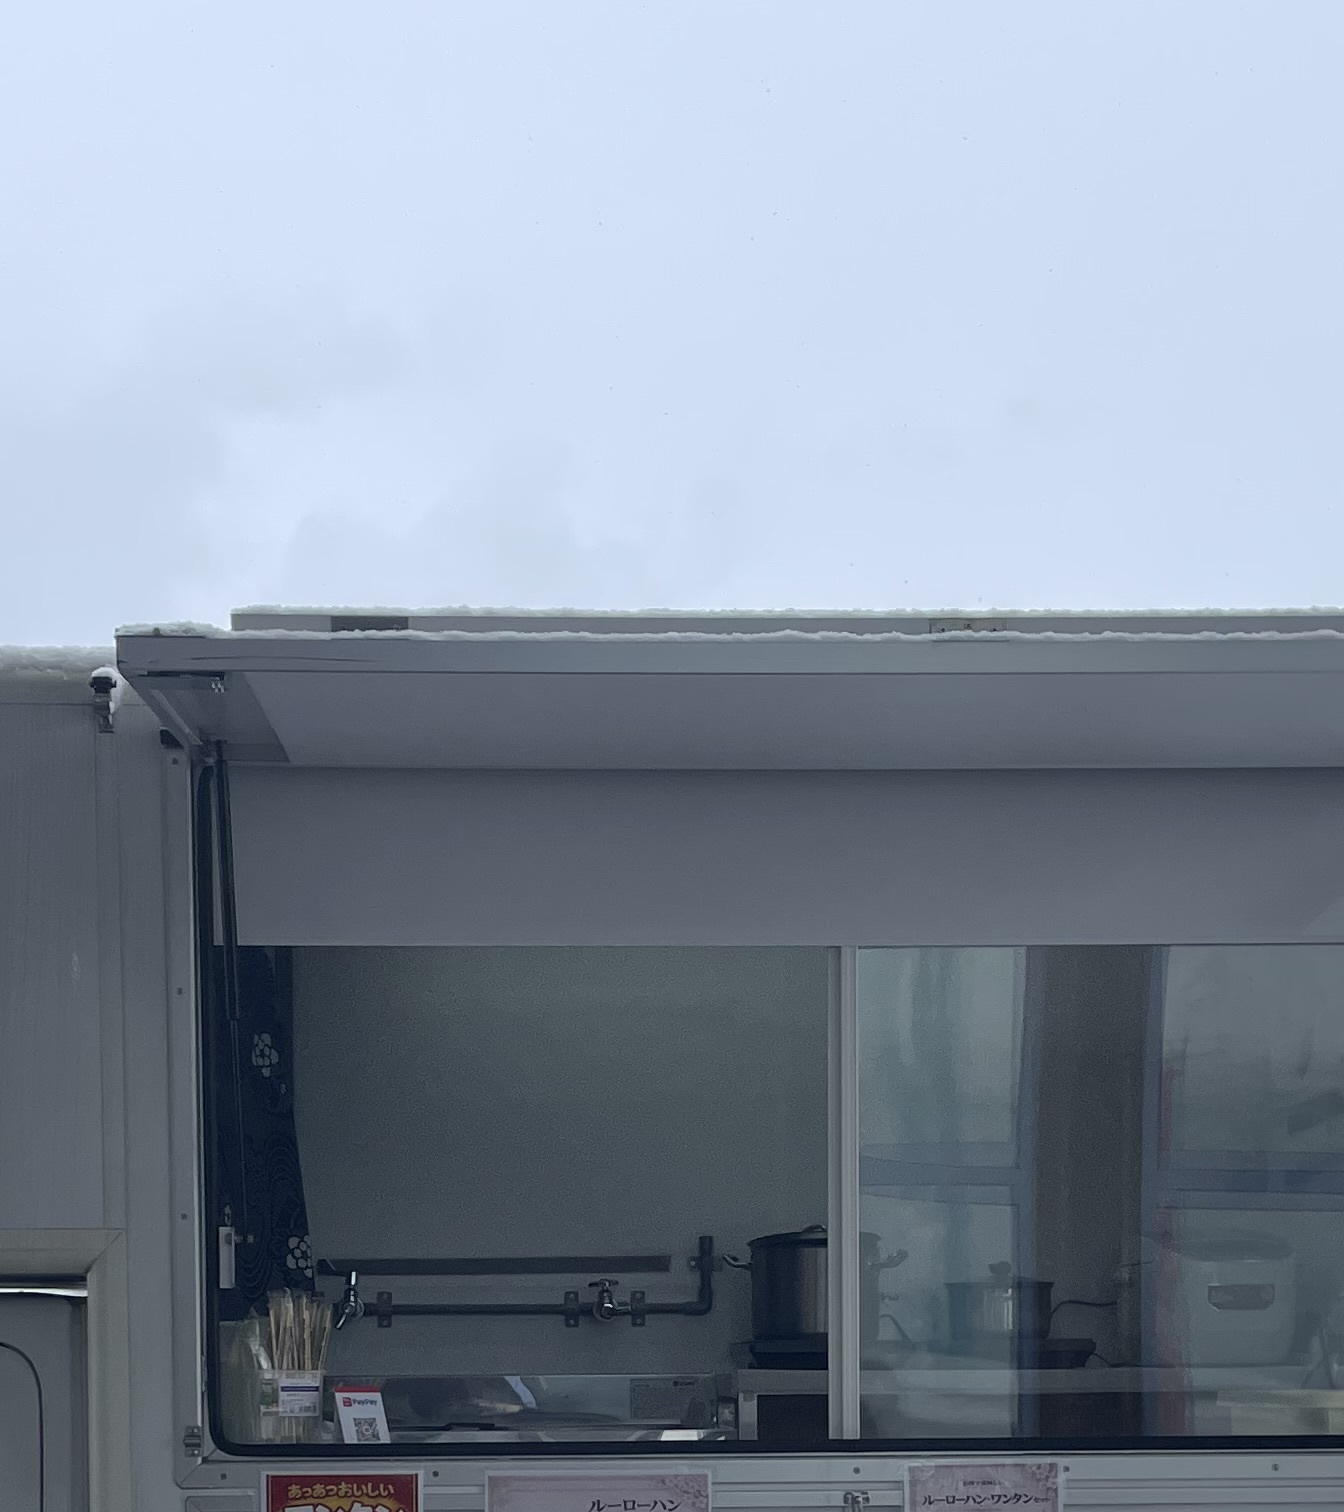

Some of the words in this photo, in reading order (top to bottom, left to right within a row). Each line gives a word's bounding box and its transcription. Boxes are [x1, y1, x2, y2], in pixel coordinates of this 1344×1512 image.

[352, 1398, 378, 1408] PayPay
[588, 1499, 682, 1512] ルーローハン
